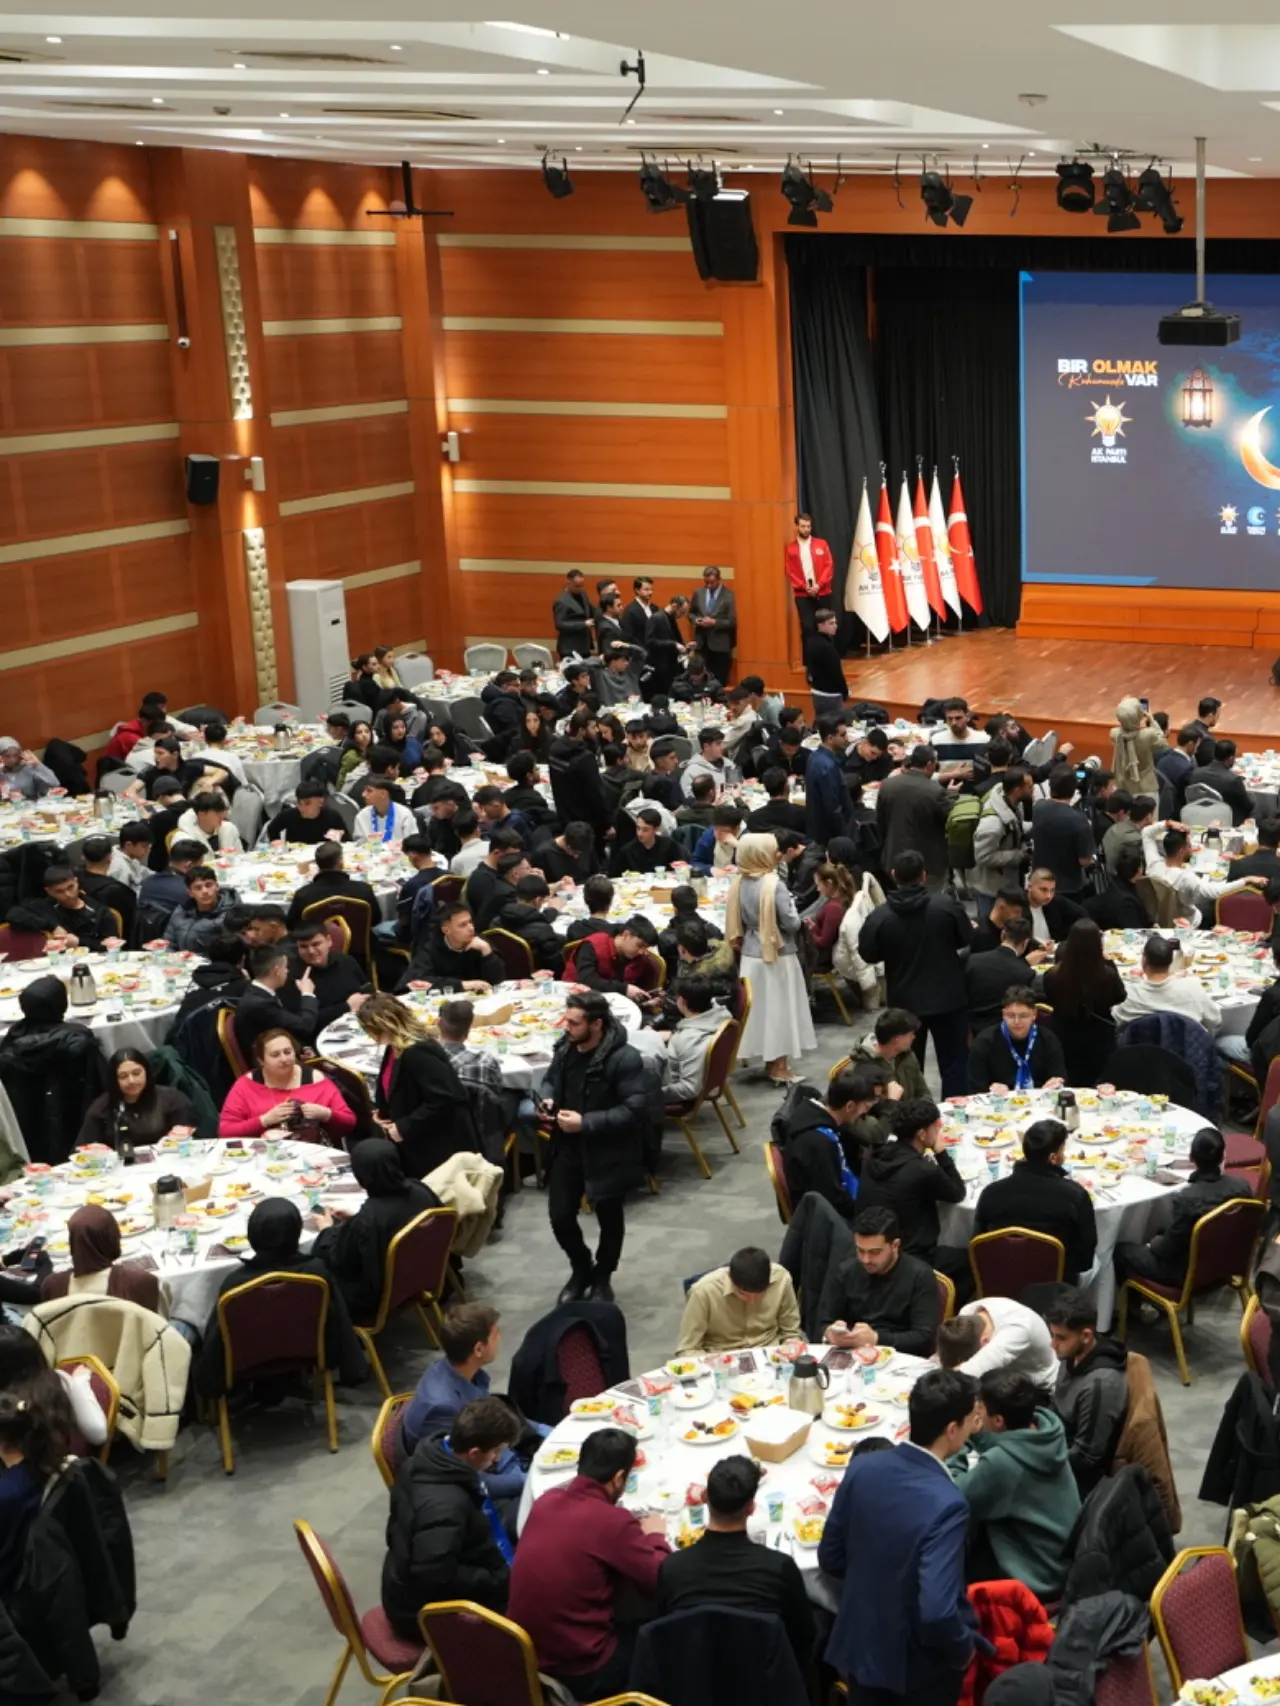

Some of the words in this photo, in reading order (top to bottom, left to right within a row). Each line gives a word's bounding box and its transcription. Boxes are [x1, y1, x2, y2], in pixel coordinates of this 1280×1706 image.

[1092, 359, 1158, 374] OLMAK
[1124, 374, 1158, 387] VAR
[1091, 447, 1104, 455] AK
